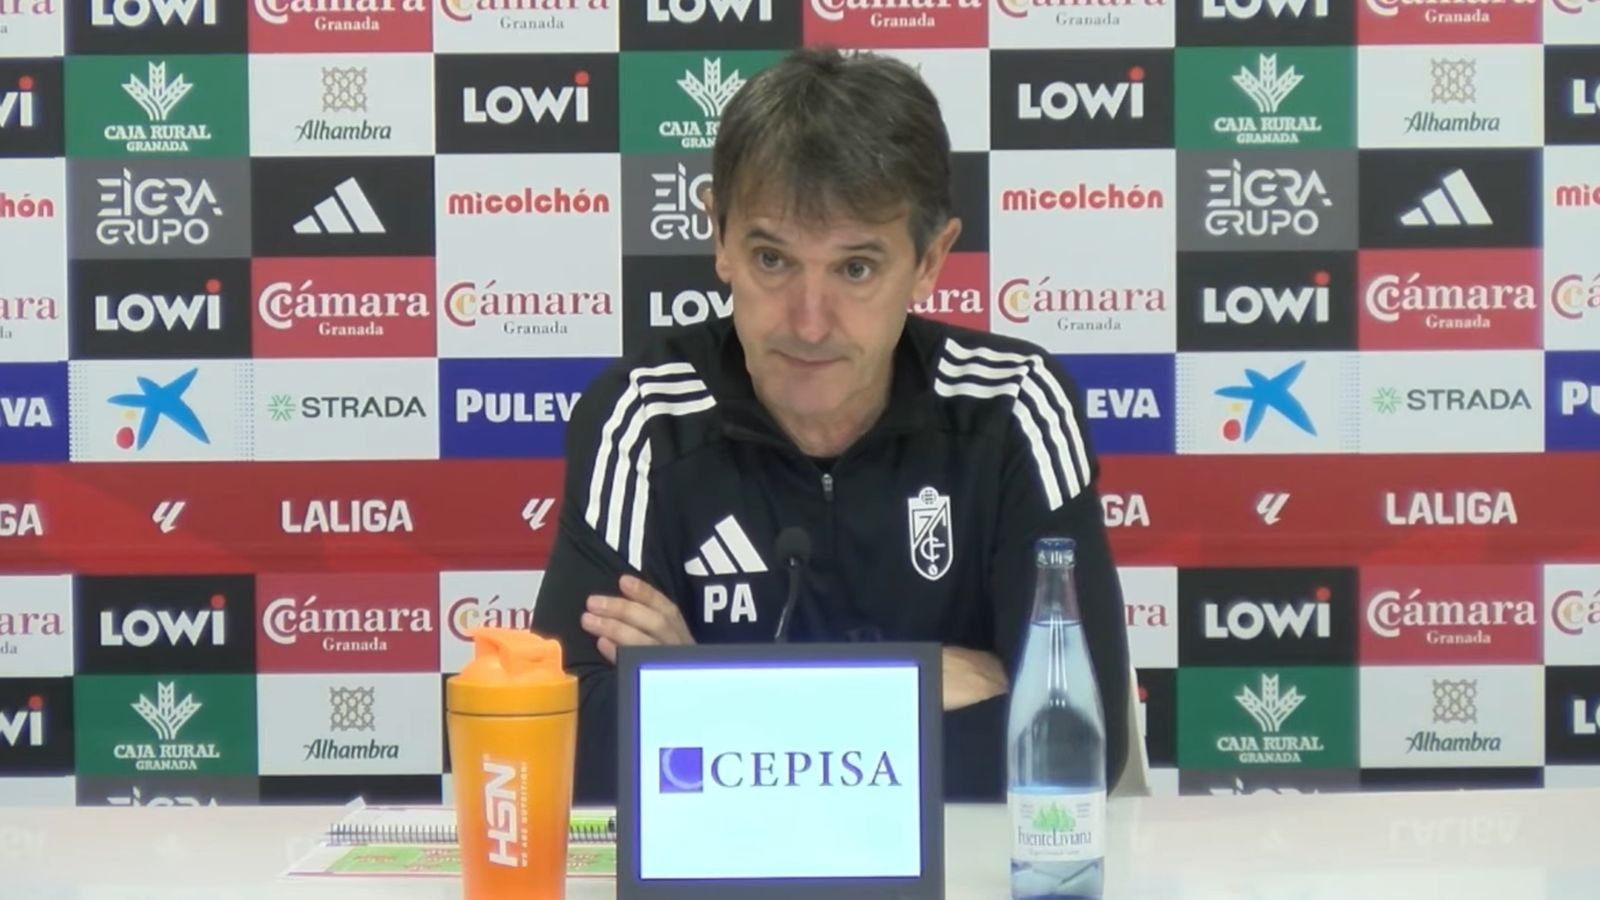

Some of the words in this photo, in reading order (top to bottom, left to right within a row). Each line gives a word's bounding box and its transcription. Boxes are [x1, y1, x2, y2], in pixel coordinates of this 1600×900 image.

[315, 16, 379, 30] Granada
[500, 16, 564, 28] Granada
[871, 12, 935, 27] Granada
[1056, 12, 1119, 25] Granada
[1425, 9, 1489, 22] Granada
[659, 121, 702, 136] CAJA
[1214, 116, 1257, 132] CAJA
[1261, 116, 1322, 132] RURAL
[1404, 111, 1499, 133] Alhambra
[104, 124, 147, 140] CAJA
[151, 124, 211, 140] RURAL
[296, 120, 391, 141] Alhambra
[1236, 133, 1299, 144] GRANADA
[126, 141, 189, 152] GRANADA
[681, 137, 716, 149] GRAN
[449, 188, 609, 214] micolchón
[1003, 184, 1163, 210] micolchón
[650, 214, 713, 240] GRU
[1205, 209, 1318, 235] GRUPO
[96, 219, 209, 244] GRUPO
[650, 289, 734, 327] LOW
[319, 321, 383, 335] Granada
[504, 321, 567, 334] Granada
[1057, 318, 1120, 330] Granada
[1426, 314, 1490, 328] Granada
[302, 396, 426, 418] STRADA
[457, 389, 581, 422] PULEV
[1087, 389, 1160, 418] EVA
[1407, 389, 1531, 410] STRADA
[282, 500, 413, 532] LALIGA
[1386, 492, 1517, 525] LALIGA
[704, 583, 757, 622] PA
[447, 595, 533, 642] Cám
[323, 637, 387, 651] Granada
[1426, 630, 1491, 643] Granada
[303, 739, 399, 760] Alhambra
[1217, 737, 1260, 751] CAJA
[1263, 736, 1324, 751] RURAL
[1405, 731, 1501, 752] Alhambra
[114, 745, 156, 759] CAJA
[160, 744, 220, 759] RURAL
[1239, 752, 1301, 763] GRANADA
[136, 760, 197, 771] GRANADA
[711, 751, 901, 787] CEPISA
[483, 761, 518, 867] HSN
